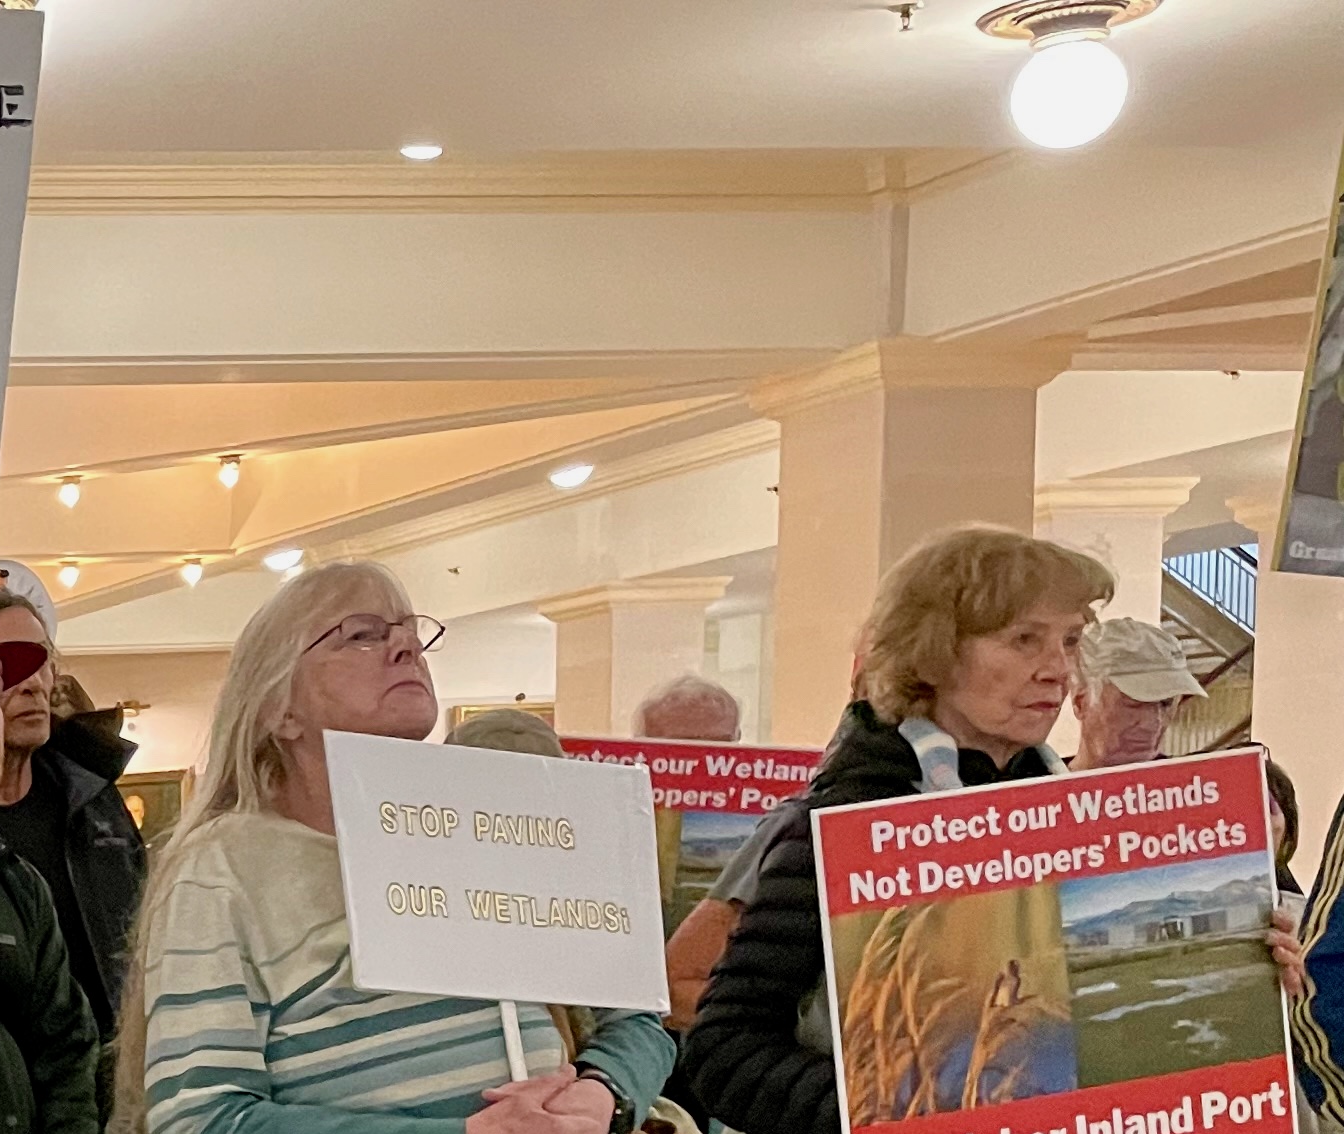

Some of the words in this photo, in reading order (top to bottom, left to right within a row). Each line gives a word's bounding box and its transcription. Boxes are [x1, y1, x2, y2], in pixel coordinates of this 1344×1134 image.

[653, 756, 699, 775] our
[706, 755, 819, 782] Wetlan
[380, 801, 459, 838] STOP
[474, 812, 575, 850] PAVING
[871, 806, 1000, 853] Protect
[1008, 801, 1062, 830] our
[1067, 776, 1220, 824] Wetlands
[849, 870, 913, 905] Not
[1118, 818, 1247, 863] Pockets
[387, 882, 448, 919] OUR
[1200, 1081, 1287, 1130] Port
